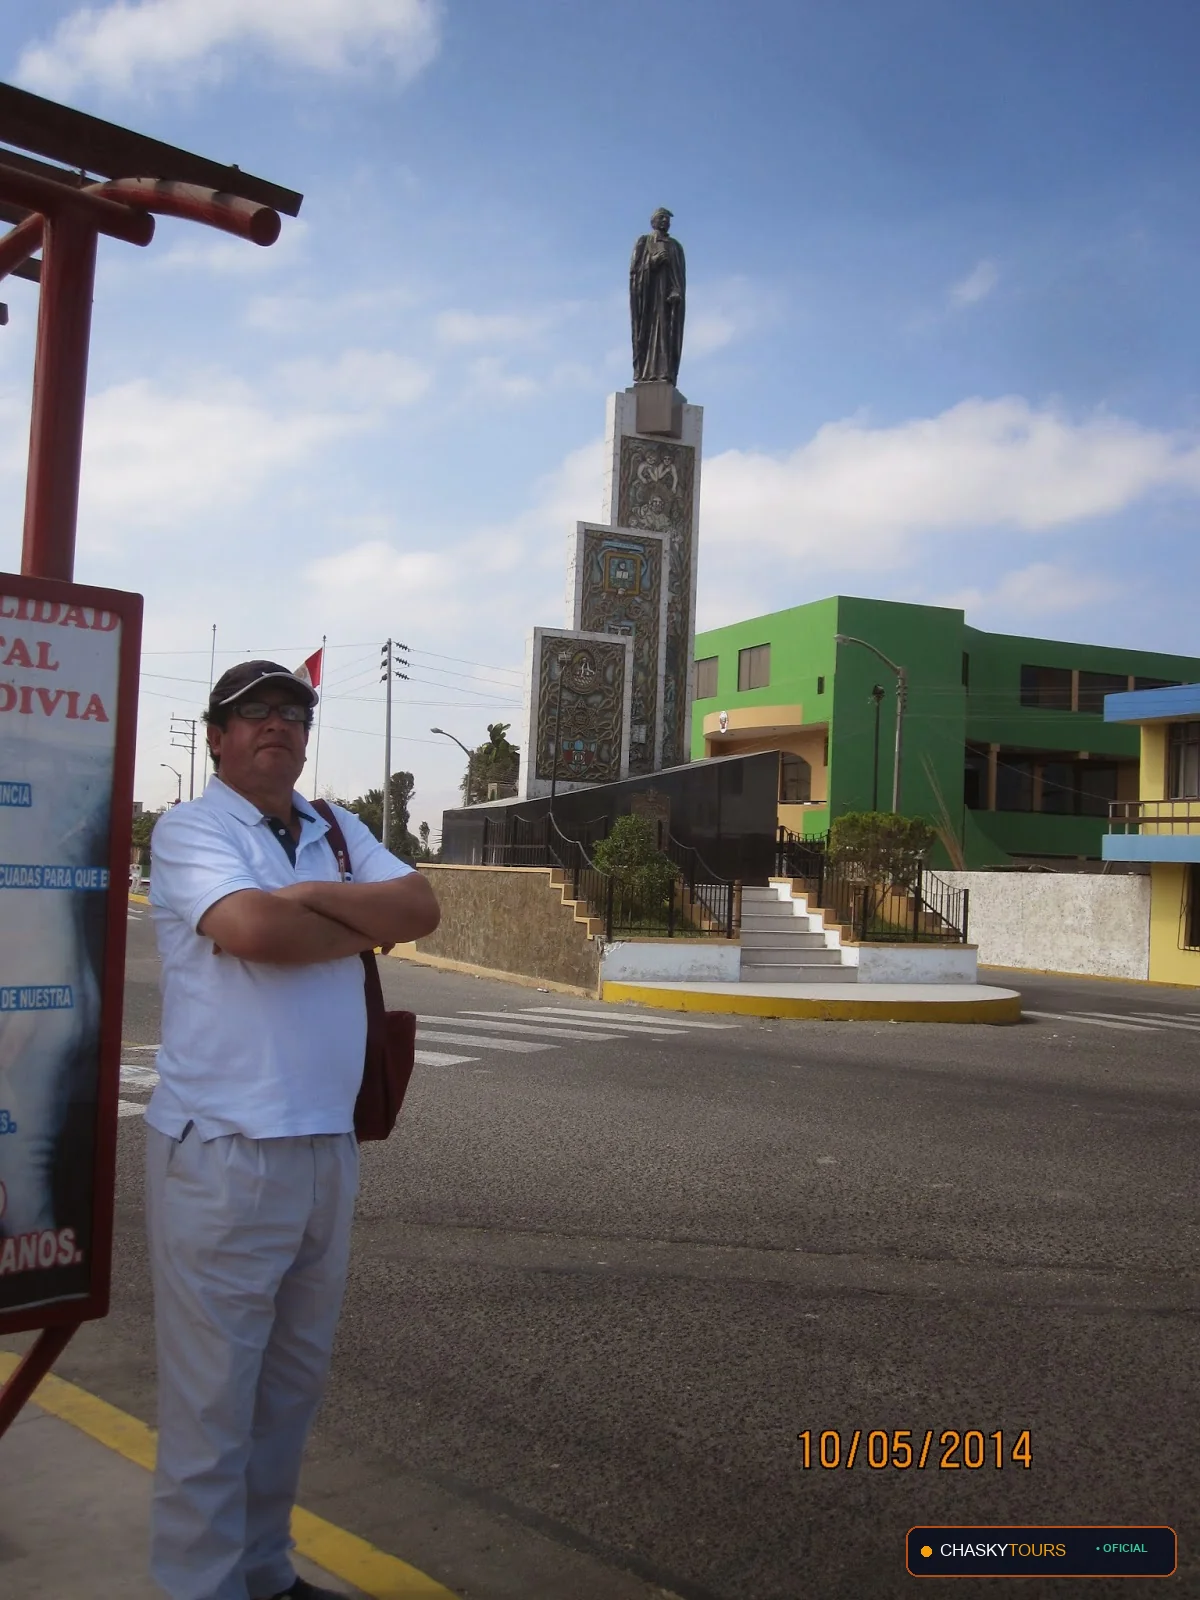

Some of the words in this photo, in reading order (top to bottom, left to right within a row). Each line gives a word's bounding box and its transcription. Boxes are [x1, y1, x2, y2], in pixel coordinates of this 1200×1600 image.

[0, 683, 109, 722] DIVIA
[43, 867, 72, 887] PARA
[75, 868, 98, 888] QUE
[2, 989, 17, 1008] DE
[19, 987, 72, 1008] NUESTRA
